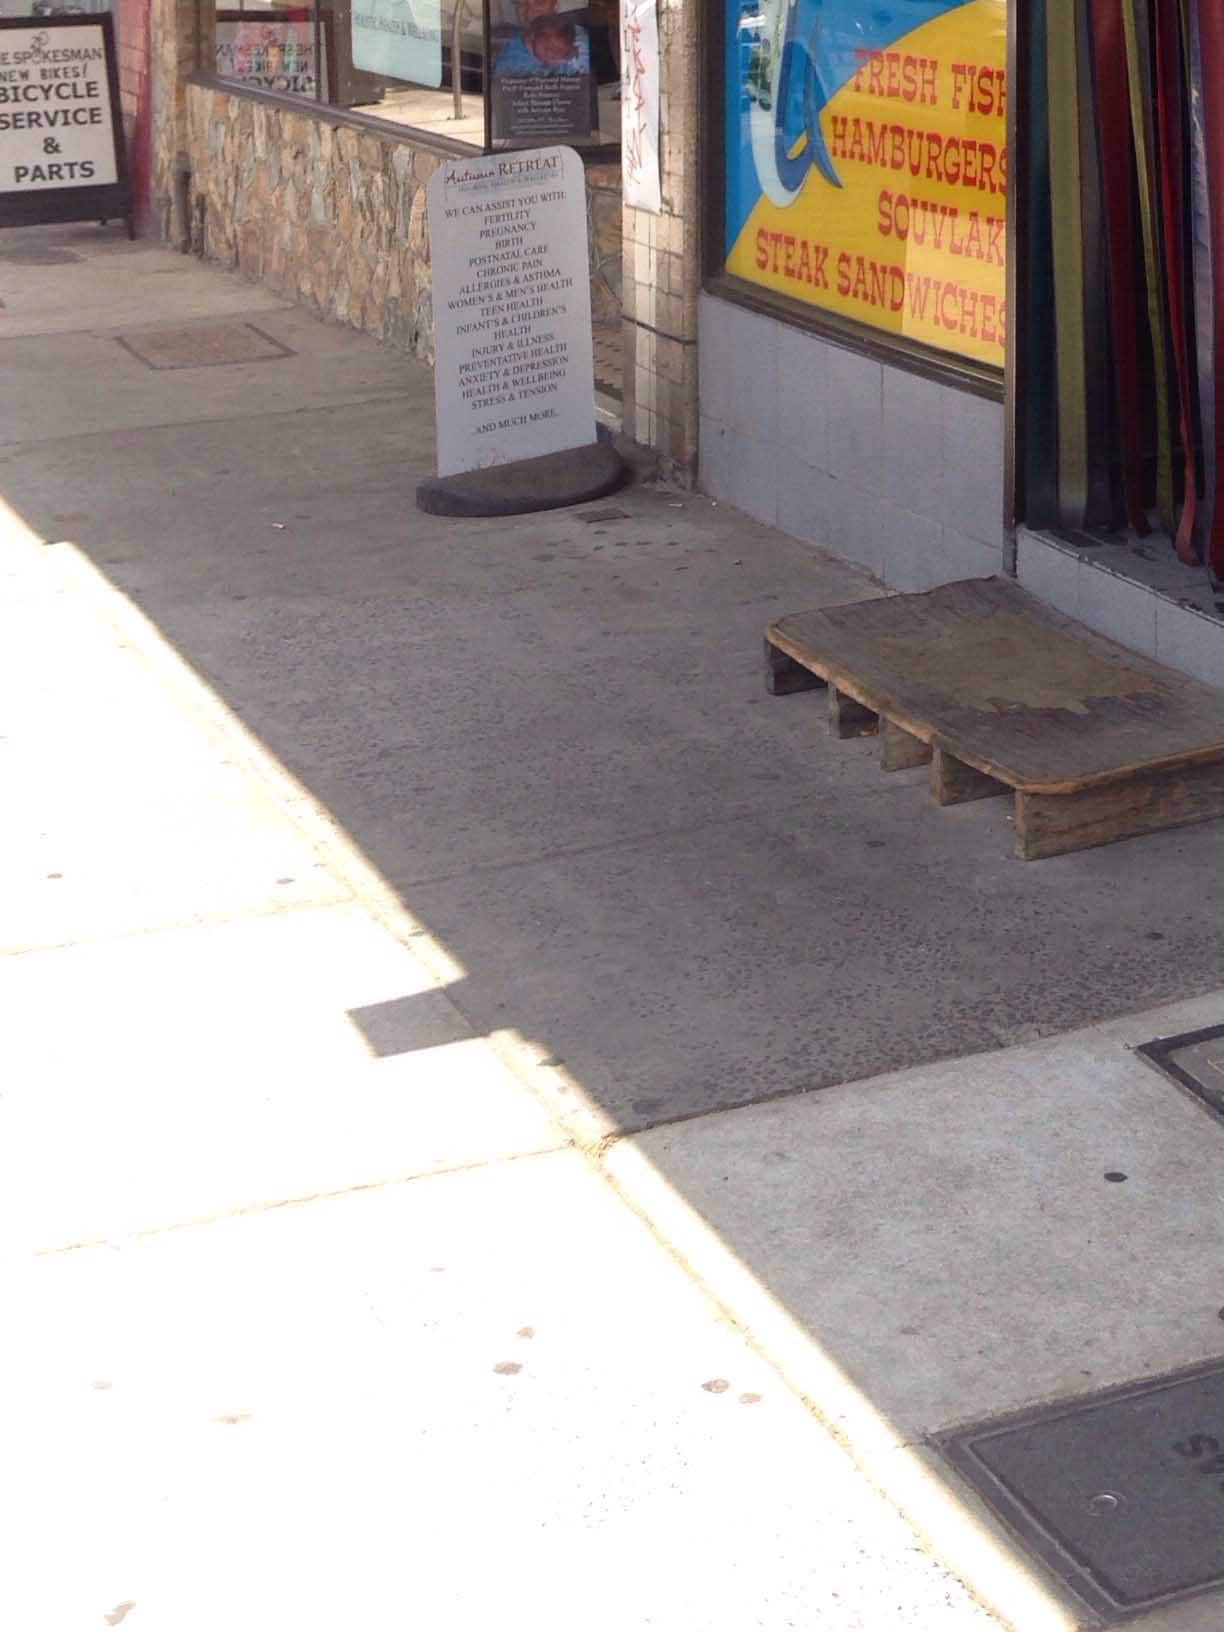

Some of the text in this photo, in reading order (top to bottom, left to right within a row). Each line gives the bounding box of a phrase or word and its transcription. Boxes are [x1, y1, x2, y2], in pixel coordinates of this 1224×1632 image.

[853, 48, 941, 106] FRESH
[0, 107, 103, 131] SERVICE
[43, 136, 61, 155] &
[14, 160, 95, 184] PARTS
[498, 155, 560, 177] RETREAT
[462, 205, 484, 217] CAN
[484, 198, 516, 212] ASSIST
[518, 194, 538, 207] YOU
[484, 209, 531, 225] FERTILITY
[480, 221, 537, 239] PREGNANCY
[495, 236, 524, 249] BIRTH
[469, 245, 548, 268] POSTNATAL CARE
[476, 258, 543, 278] CHRONIC PAIN
[755, 228, 829, 290] STEAK
[459, 277, 511, 296] ALLERGIES
[523, 268, 561, 283] ASTHMA
[536, 277, 573, 292] HEALTH
[481, 296, 544, 318] TEEN HEALTH
[494, 324, 532, 341] HEALTH
[472, 344, 505, 359] INJURY
[516, 333, 555, 348] ILLNESS
[459, 342, 568, 375] PREVENTATIVE HEALTH
[459, 370, 501, 388] ANXIETY
[512, 354, 569, 376] DEPRESSION
[462, 382, 501, 400] HEALTH
[511, 369, 567, 387] WELLBEING
[472, 394, 506, 410] STRESS
[518, 382, 558, 400] TENSION
[498, 414, 528, 429] MUCH
